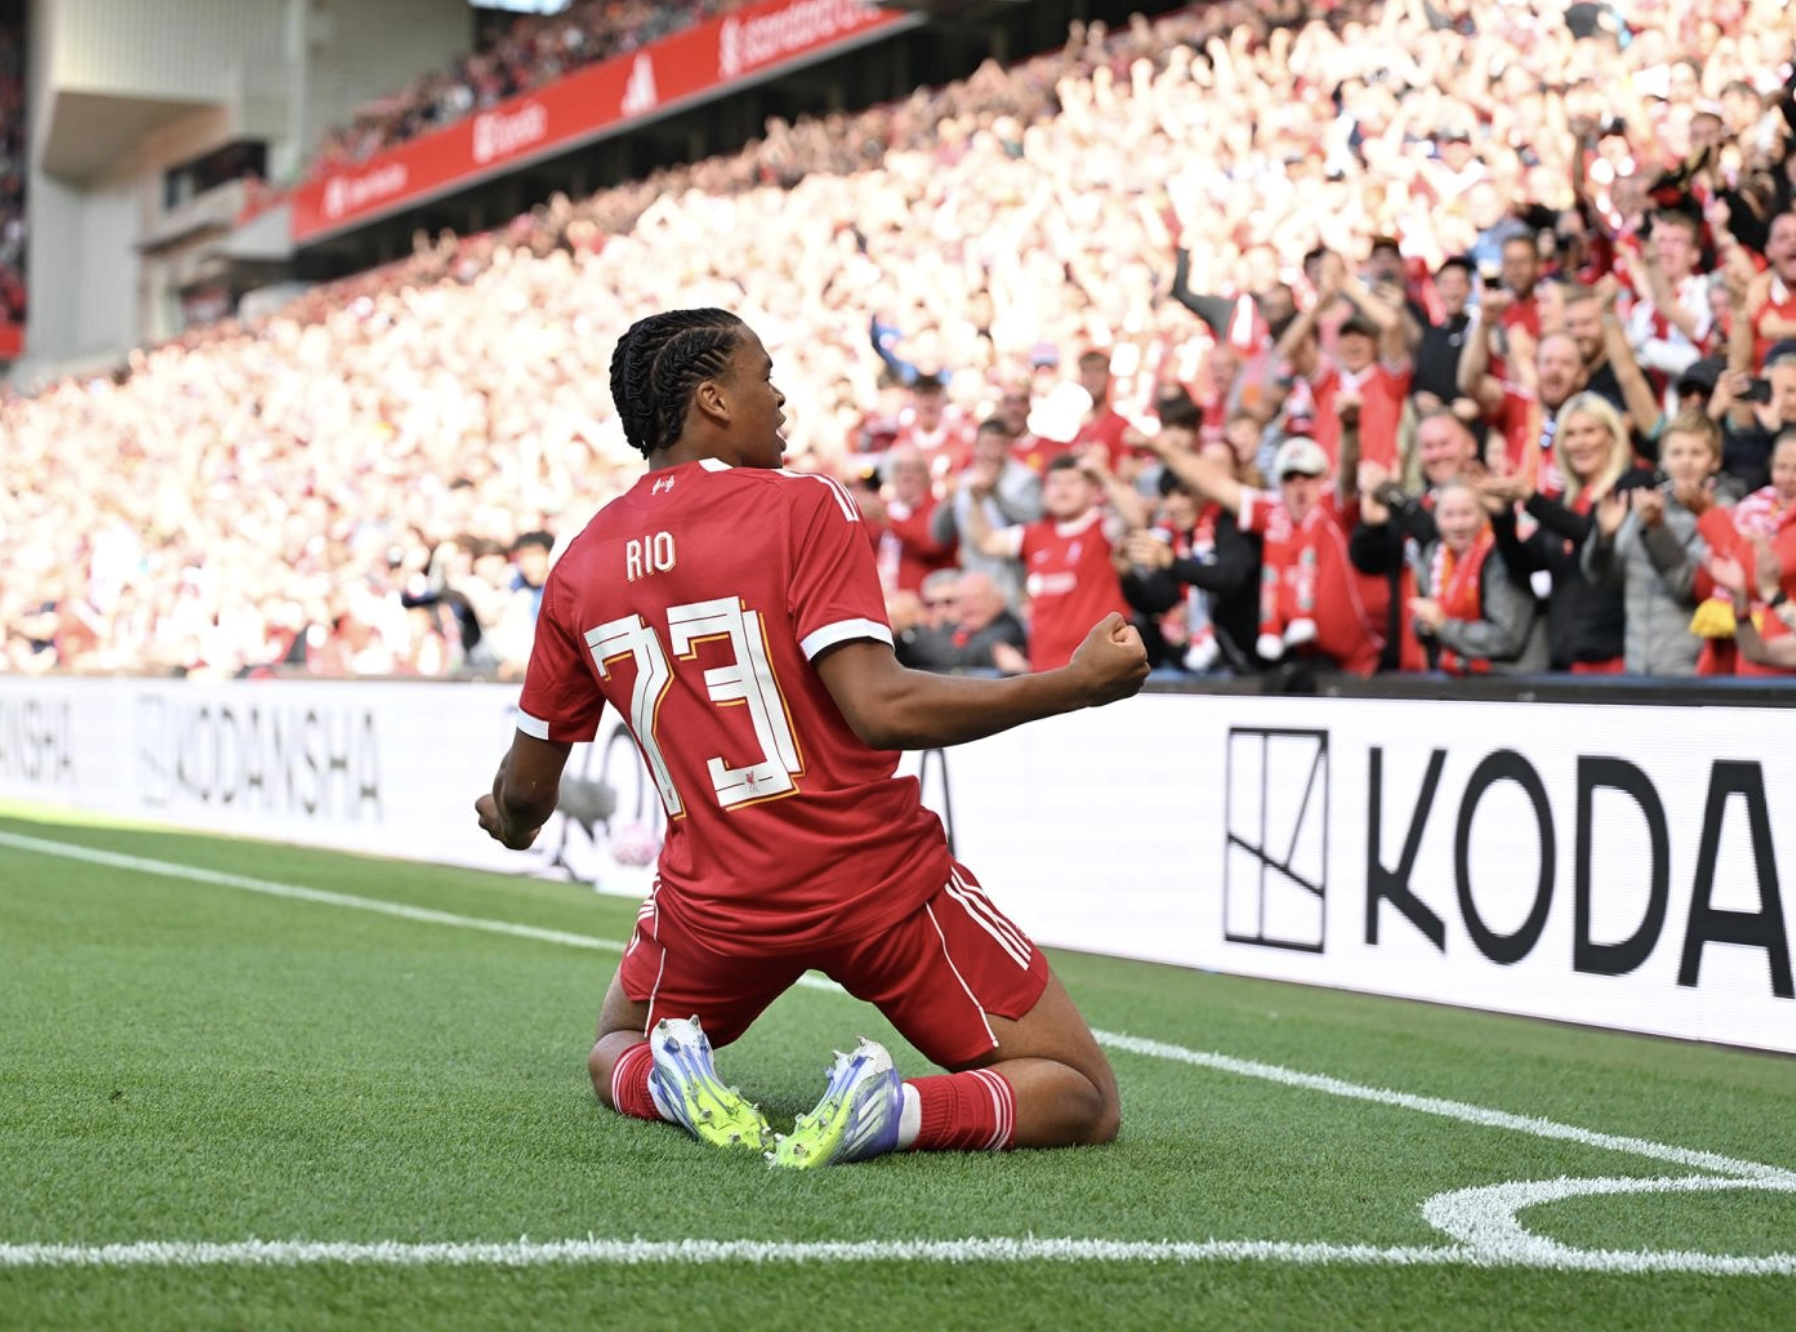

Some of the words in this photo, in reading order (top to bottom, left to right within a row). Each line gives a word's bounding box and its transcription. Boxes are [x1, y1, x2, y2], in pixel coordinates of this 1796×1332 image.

[626, 531, 676, 582] RIO
[584, 596, 805, 820] 73
[1364, 747, 1796, 999] KODA
